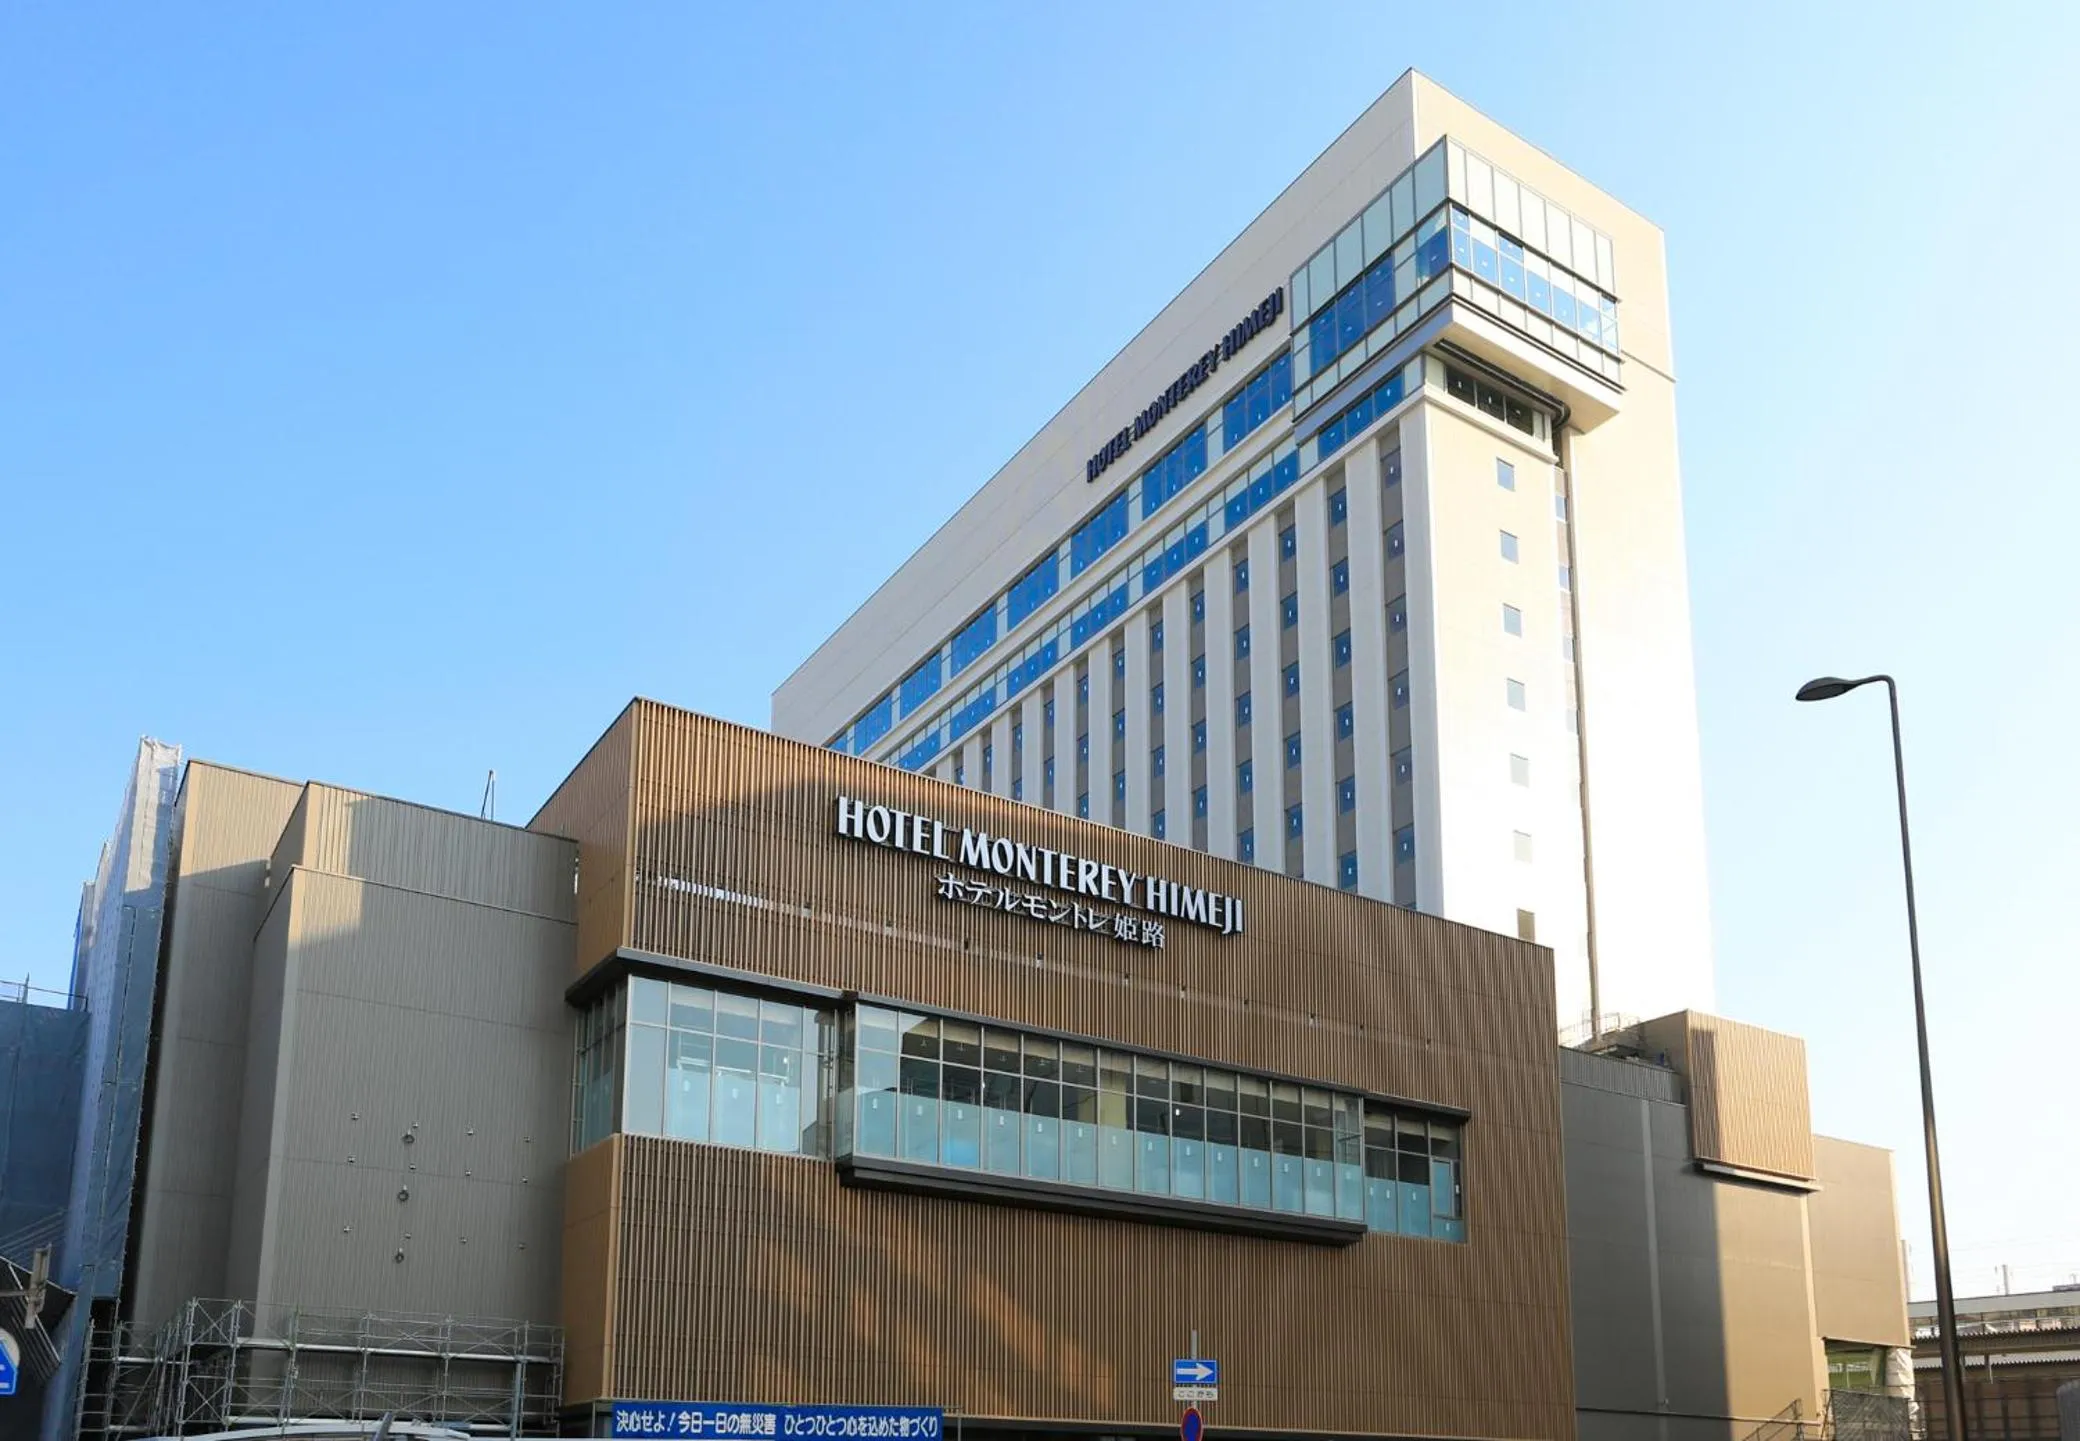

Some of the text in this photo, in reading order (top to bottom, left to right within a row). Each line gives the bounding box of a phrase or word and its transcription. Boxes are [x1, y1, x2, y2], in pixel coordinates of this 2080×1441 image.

[1087, 287, 1284, 483] HOTEL MONTEREY HIMEJI
[837, 796, 1246, 935] HOTEL MONTEREY HIMEJI
